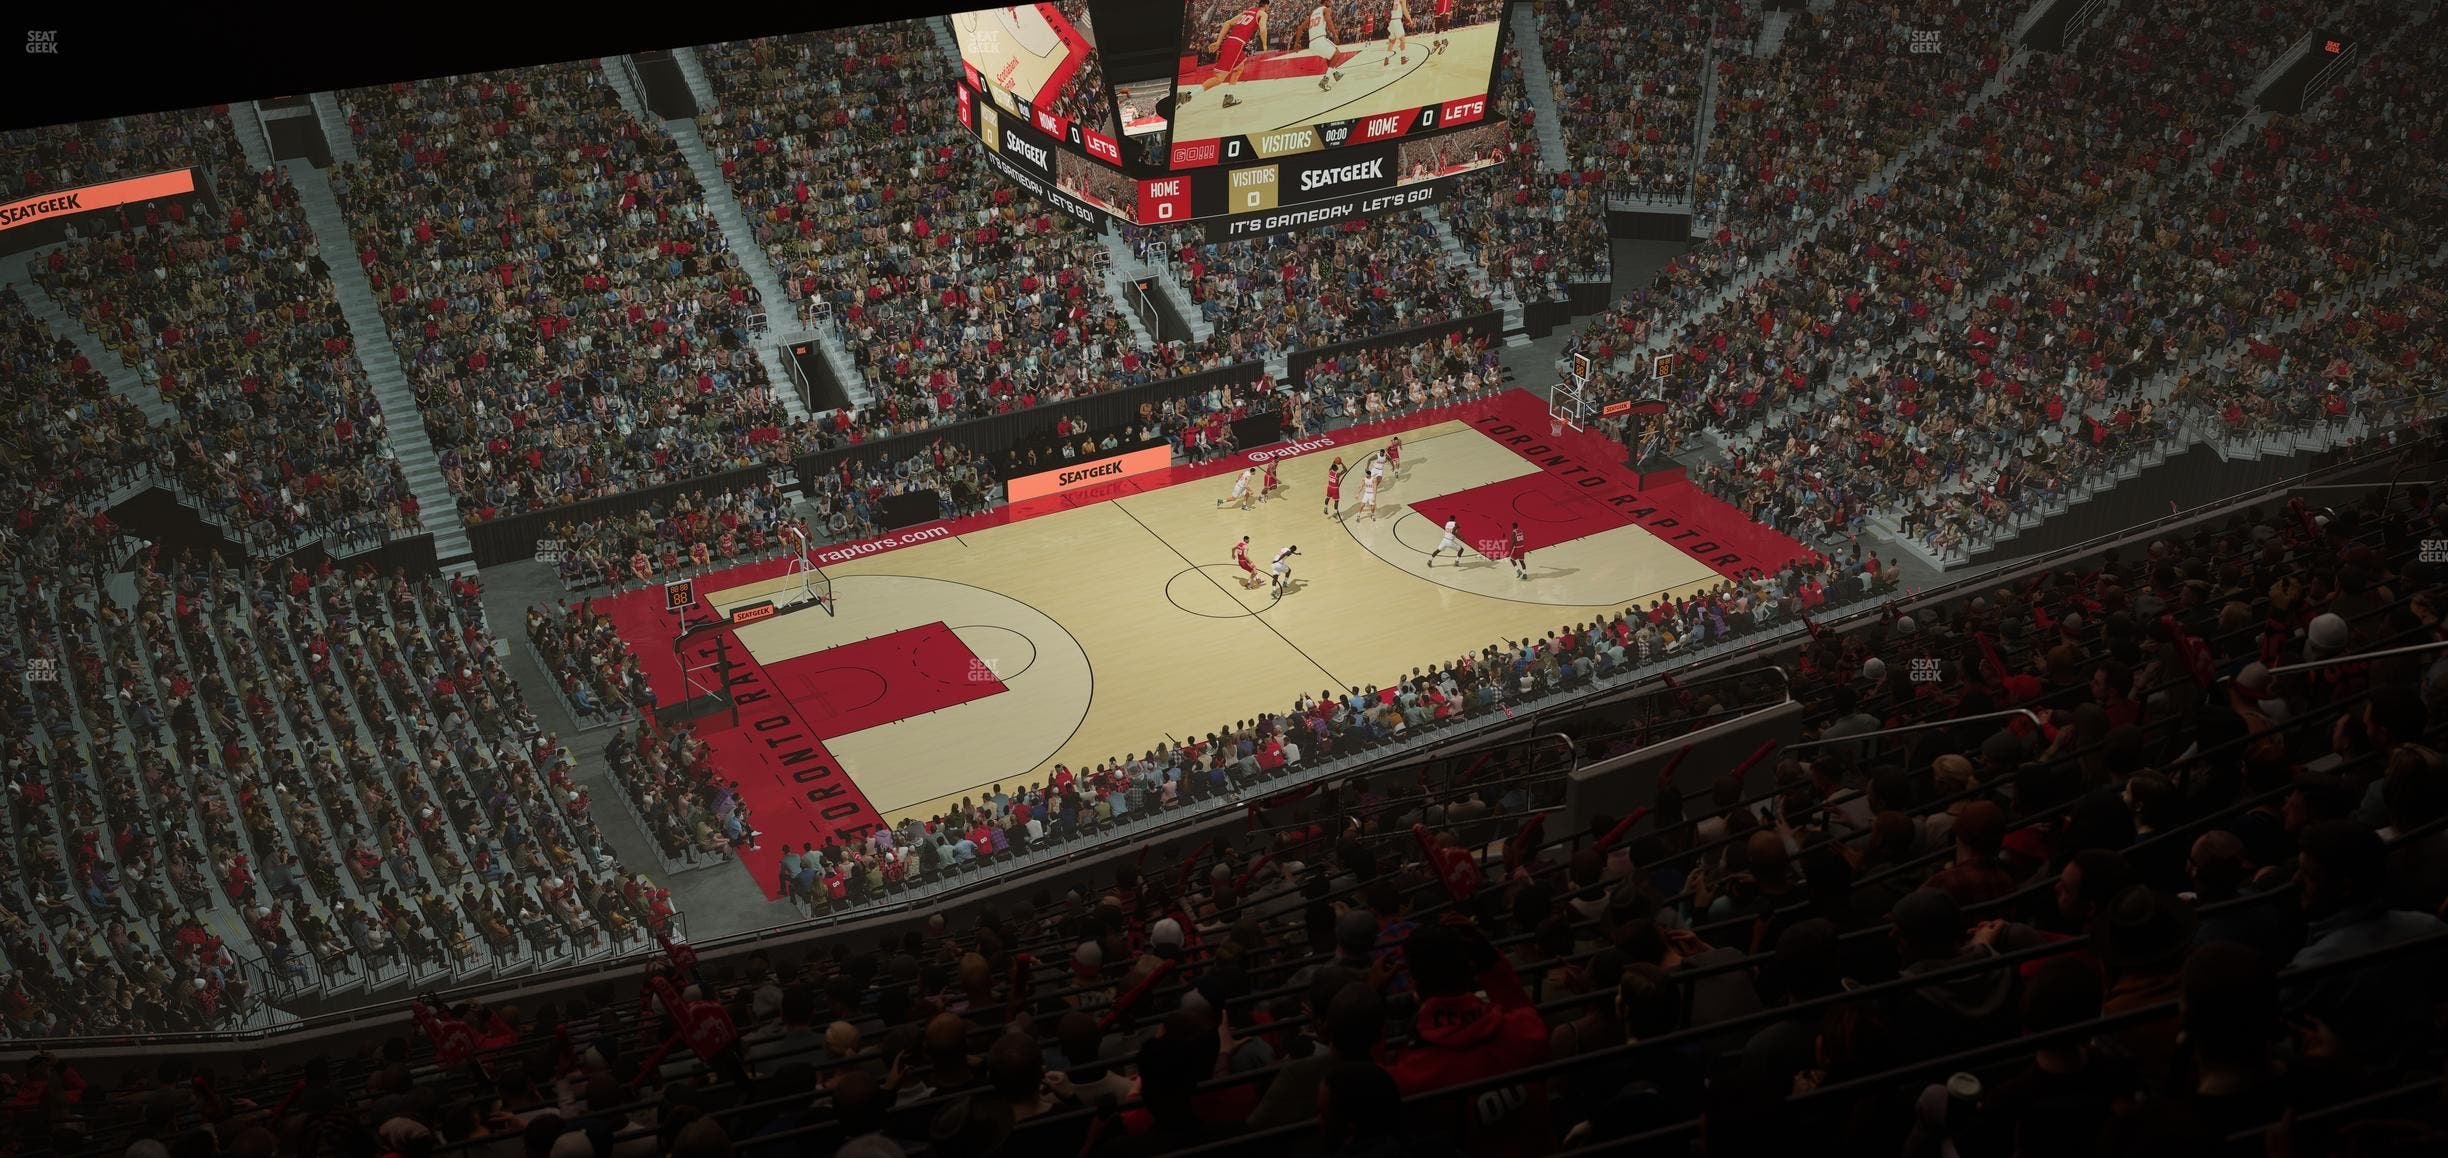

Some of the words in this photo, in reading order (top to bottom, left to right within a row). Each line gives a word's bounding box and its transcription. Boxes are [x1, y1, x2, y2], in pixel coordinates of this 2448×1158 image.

[1422, 110, 1434, 127] 0
[1445, 102, 1484, 121] LET'S
[1038, 111, 1059, 135] HOME
[1367, 116, 1400, 137] HOME
[1071, 127, 1081, 143] 0
[1262, 130, 1312, 154] VISITORS
[1326, 128, 1348, 142] 00:00
[1006, 130, 1048, 172] SEATGEEK
[1087, 138, 1118, 158] LET'S
[1174, 145, 1215, 162] GO!!!
[1228, 141, 1240, 157] 0
[1232, 169, 1275, 187] VISITORS
[1301, 157, 1384, 191] SEATGEEK
[1001, 161, 1043, 196] GAMEDAY
[1047, 190, 1075, 213] LET'S
[1075, 206, 1094, 223] GO!
[1151, 180, 1180, 198] HOME
[0, 193, 82, 226] SEATGEEK
[1247, 192, 1260, 207] 0
[1158, 203, 1173, 218] 0
[1230, 219, 1262, 235] IT'S
[1265, 203, 1353, 230] GAMEDAY
[1362, 194, 1405, 213] LET'S
[1407, 187, 1433, 203] GO!
[1248, 437, 1335, 463] @raptors
[1059, 460, 1124, 486] SEATGEEK
[1475, 415, 1607, 488] TORONTO
[1607, 494, 1765, 581] RAPTORS
[817, 525, 949, 565] raptors.com
[737, 607, 770, 621] SEATGEEK
